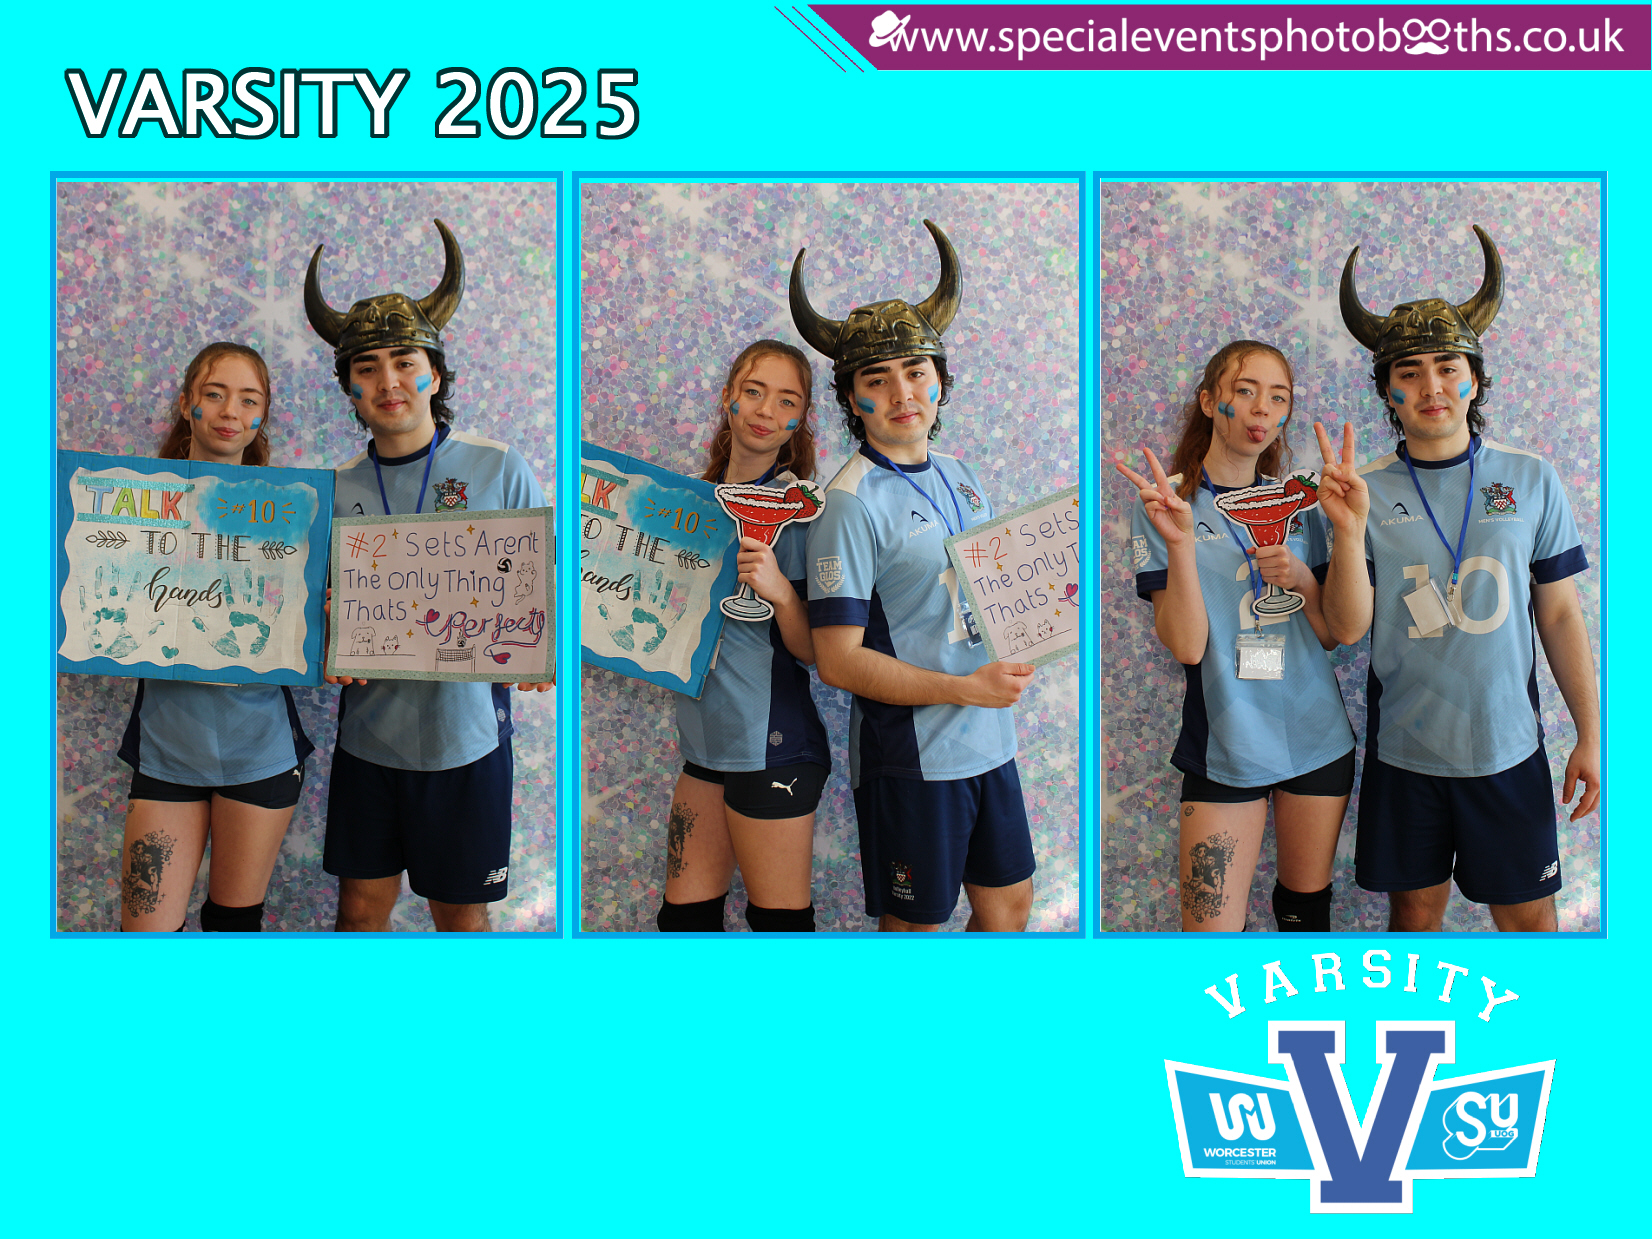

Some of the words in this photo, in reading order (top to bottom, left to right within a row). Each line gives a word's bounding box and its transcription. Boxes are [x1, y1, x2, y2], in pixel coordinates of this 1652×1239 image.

[85, 485, 184, 520] TALK
[231, 499, 275, 524] #10
[657, 507, 700, 534] #10
[908, 519, 940, 539] AKUMA
[1379, 514, 1424, 527] AKUMA
[140, 530, 178, 556] TO
[191, 532, 252, 562] THE
[345, 531, 388, 559] #2
[405, 530, 467, 558] Sets
[616, 524, 671, 565] THE
[963, 536, 1008, 569] #2
[1019, 510, 1080, 547] Sets
[816, 560, 843, 573] TEAM
[819, 570, 841, 582] GLOS
[143, 566, 223, 613] hands
[344, 568, 382, 590] The
[444, 569, 505, 607] Thing
[973, 570, 1013, 597] The
[1402, 555, 1510, 639] 10
[343, 599, 407, 622] Thats
[983, 587, 1049, 625] Thats
